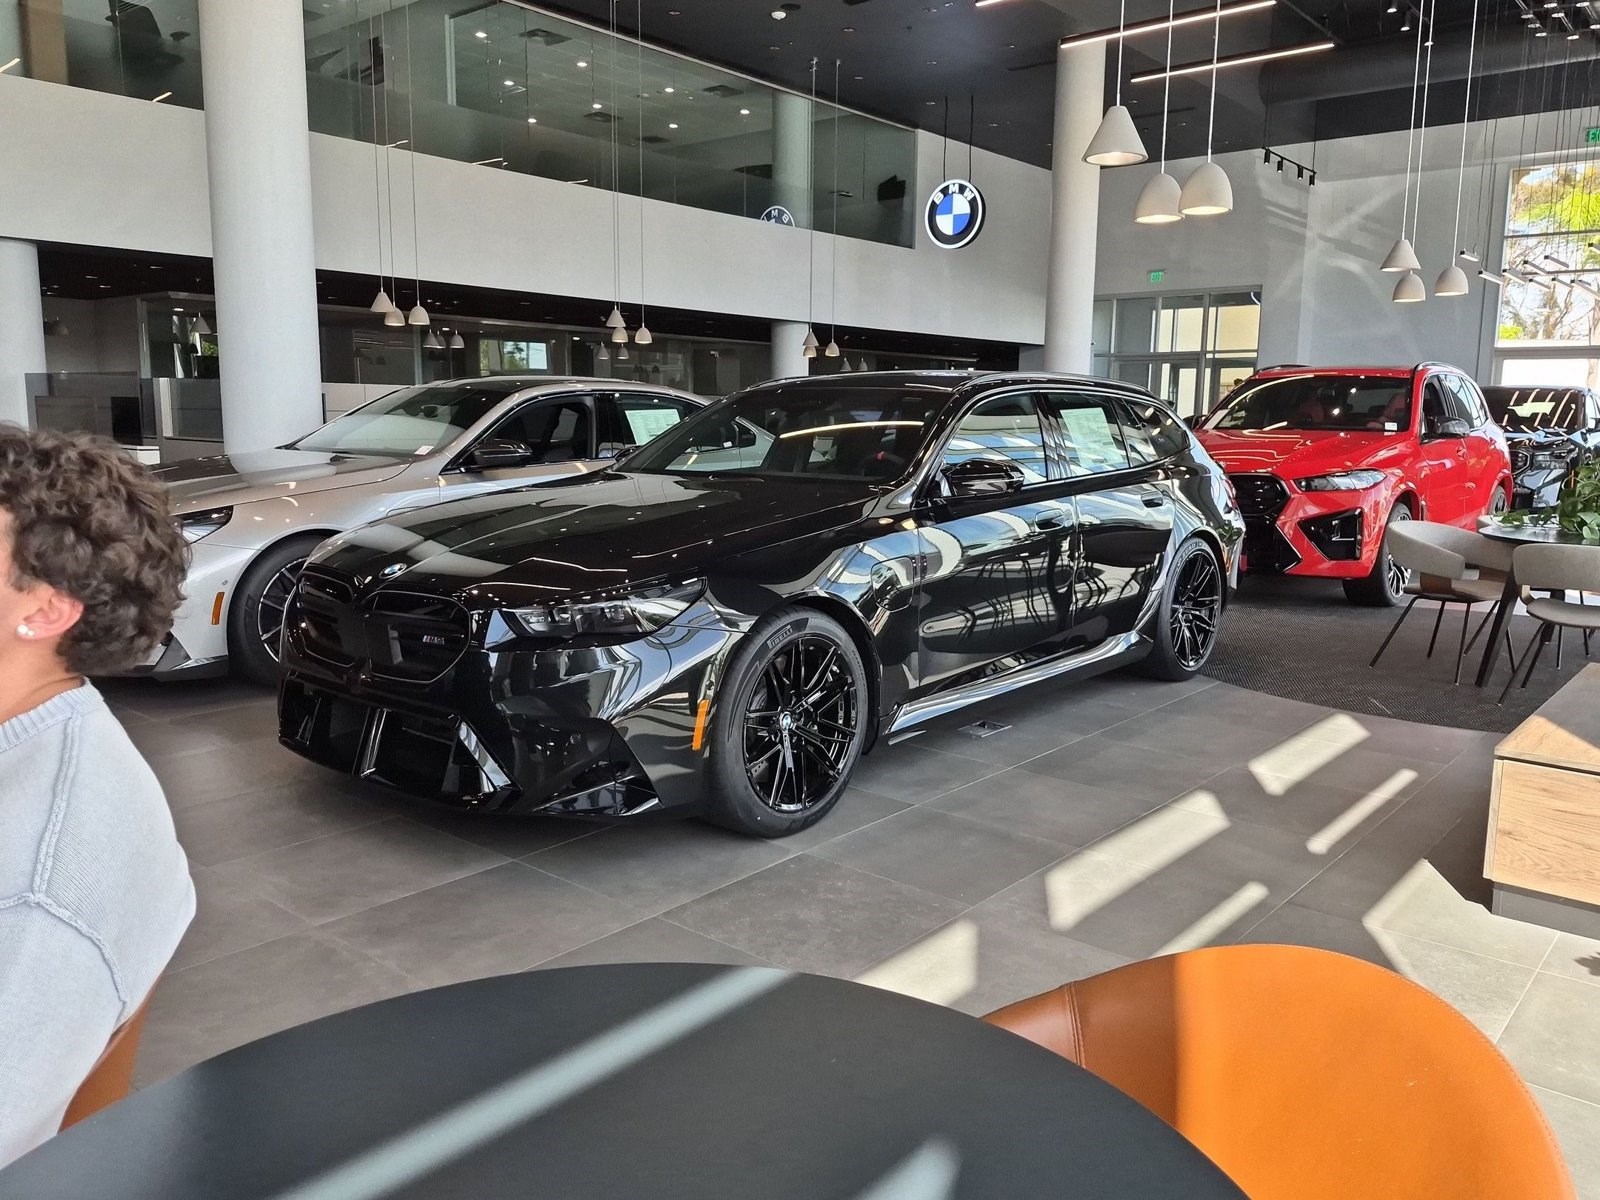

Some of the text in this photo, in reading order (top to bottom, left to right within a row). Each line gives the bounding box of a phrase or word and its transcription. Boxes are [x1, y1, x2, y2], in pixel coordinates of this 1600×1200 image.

[1589, 130, 1600, 142] EX
[933, 183, 975, 205] BMW
[766, 624, 793, 649] PIRELLI
